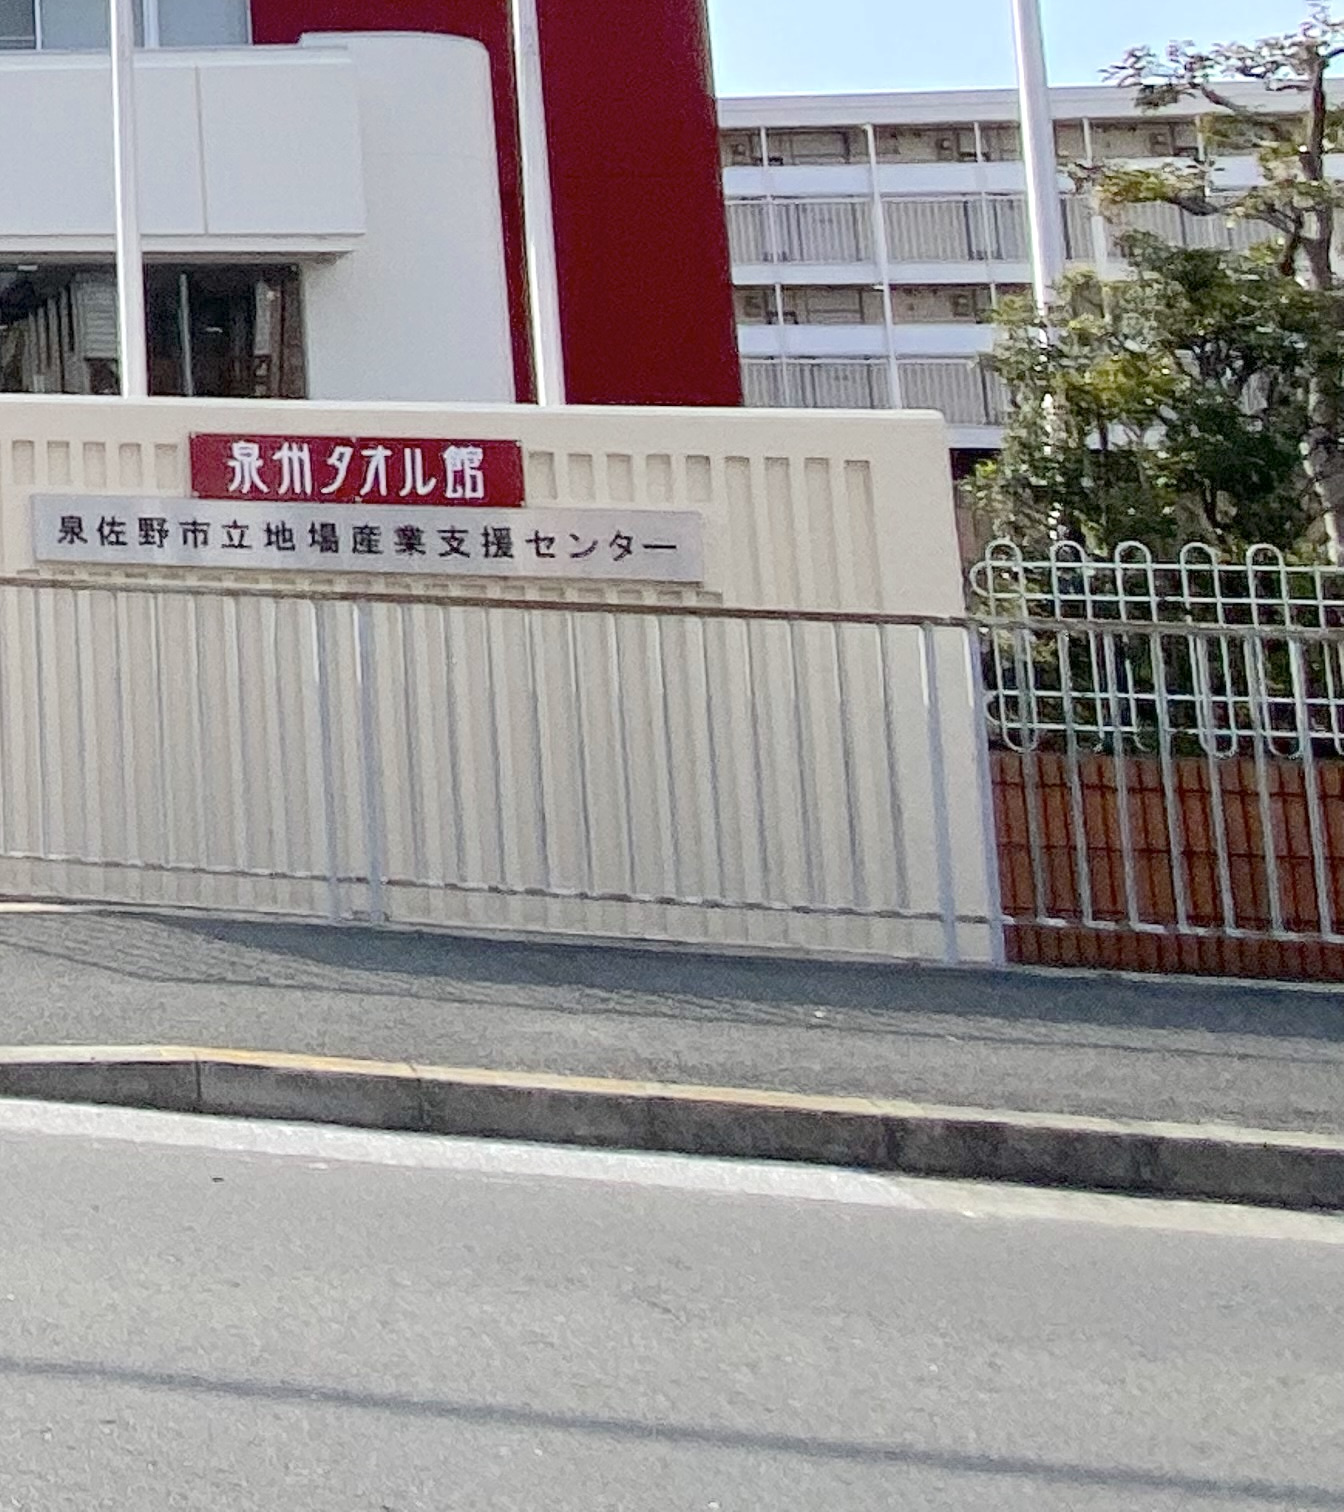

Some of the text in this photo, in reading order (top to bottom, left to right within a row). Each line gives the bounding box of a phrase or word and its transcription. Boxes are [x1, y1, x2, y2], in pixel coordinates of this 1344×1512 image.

[227, 441, 484, 500] 泉州タオル館
[57, 515, 677, 561] 泉佐野市立地場産業支援センター
